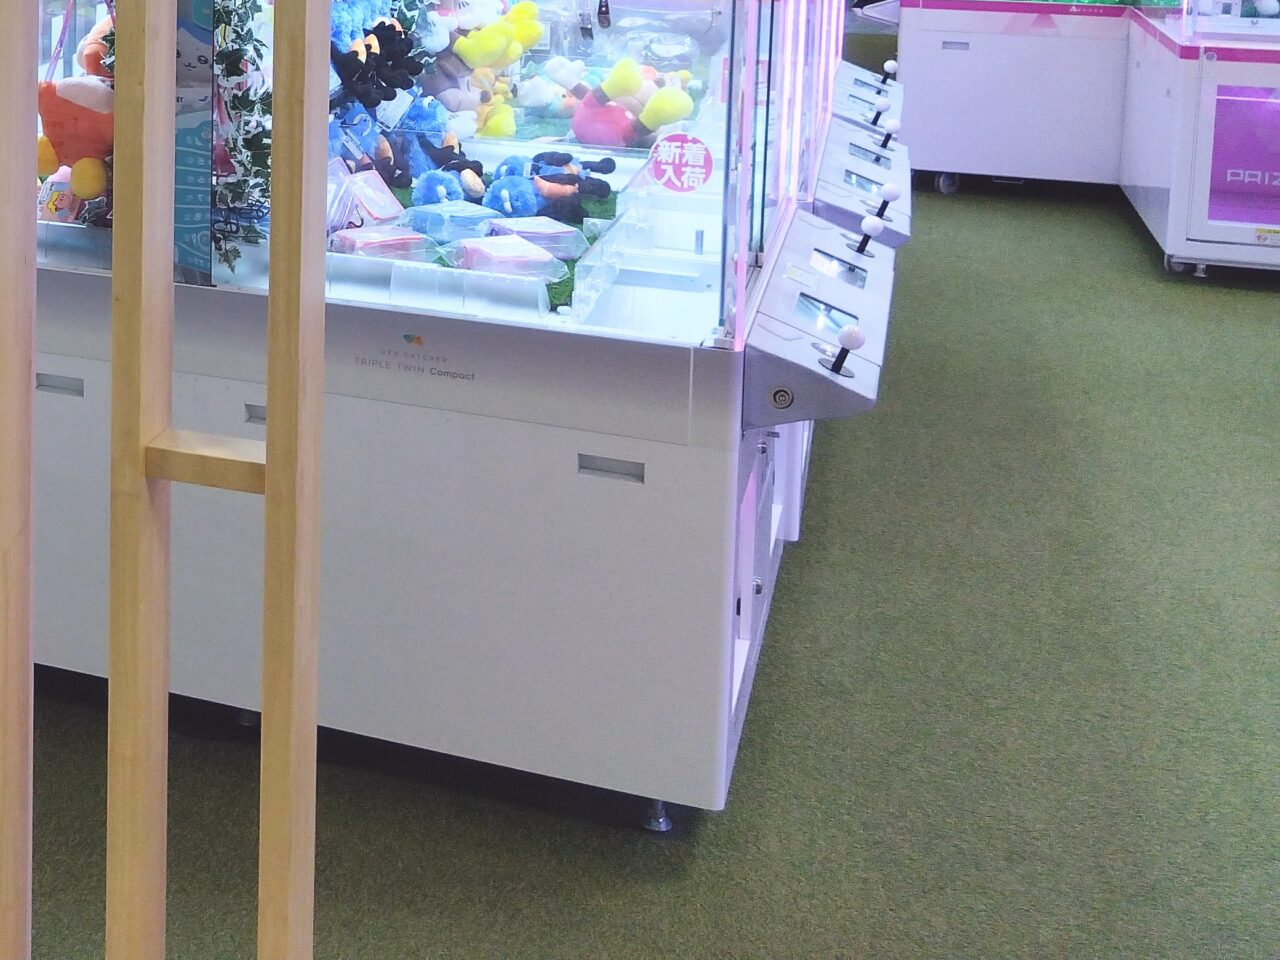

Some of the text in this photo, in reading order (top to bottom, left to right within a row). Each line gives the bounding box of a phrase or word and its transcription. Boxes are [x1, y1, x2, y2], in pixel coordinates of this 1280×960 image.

[656, 139, 706, 166] 新着
[656, 165, 707, 190] 入荷
[356, 357, 475, 381] TRIPLE TWIN Compact
